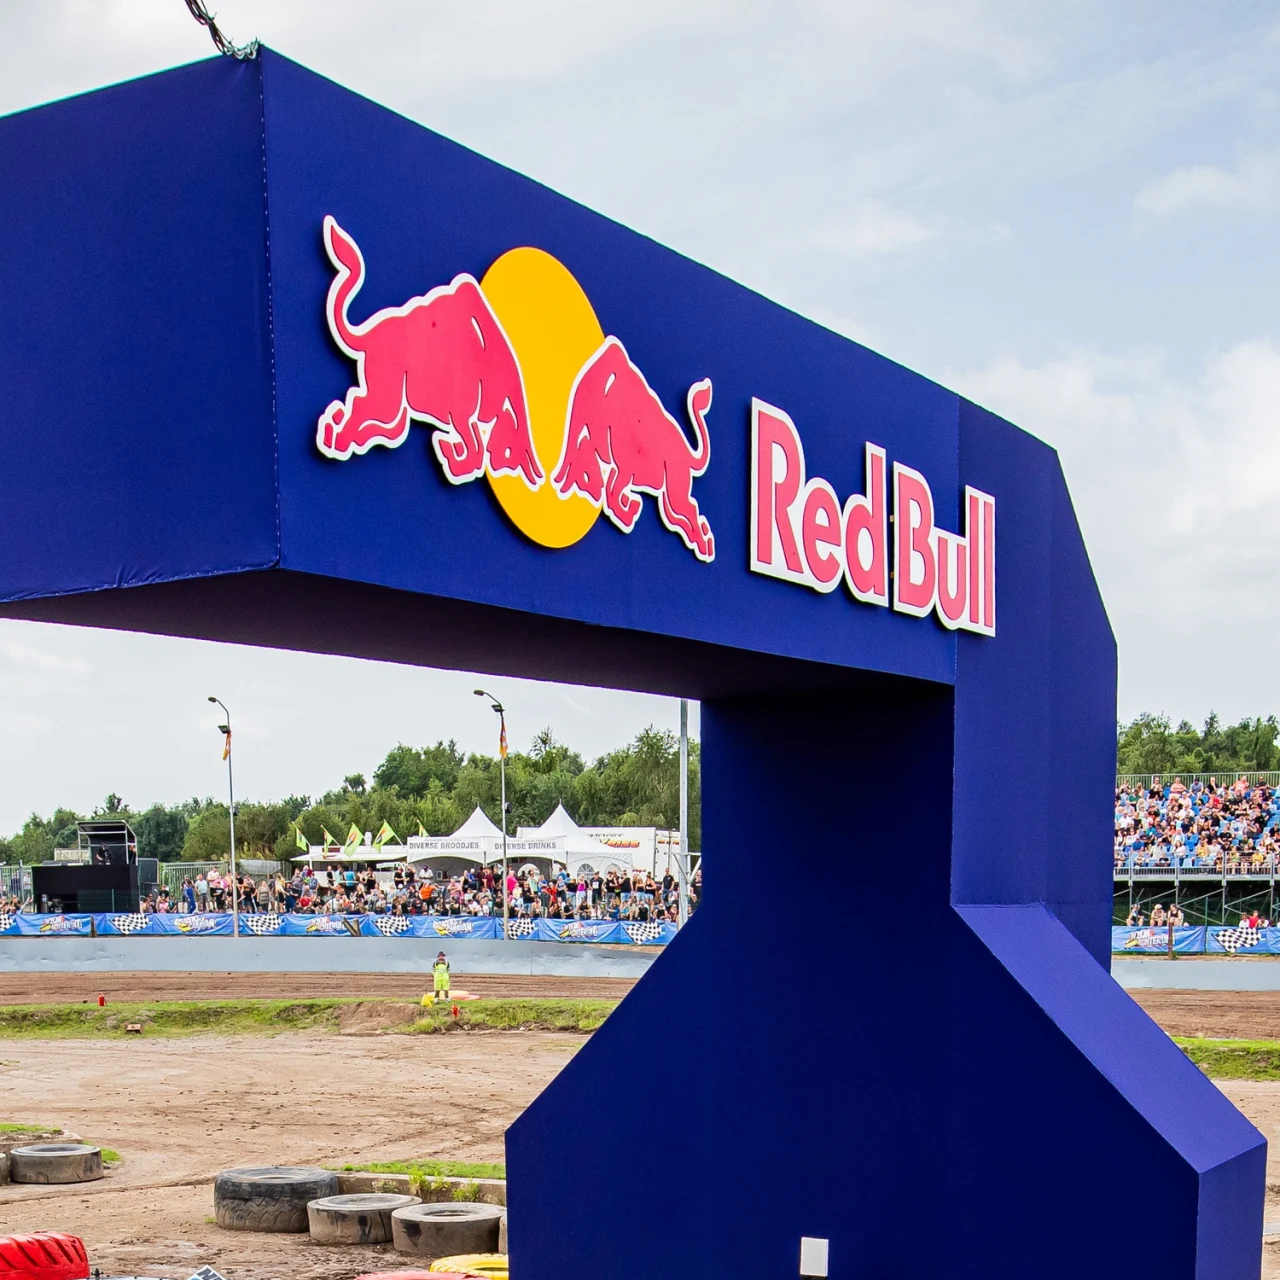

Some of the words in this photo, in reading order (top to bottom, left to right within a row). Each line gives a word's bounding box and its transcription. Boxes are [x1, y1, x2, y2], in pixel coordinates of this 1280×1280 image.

[752, 399, 888, 605] Red
[895, 463, 994, 635] Bull
[409, 841, 439, 850] DIVERSE
[440, 841, 479, 850] BROODJES
[528, 841, 557, 850] DRINKS
